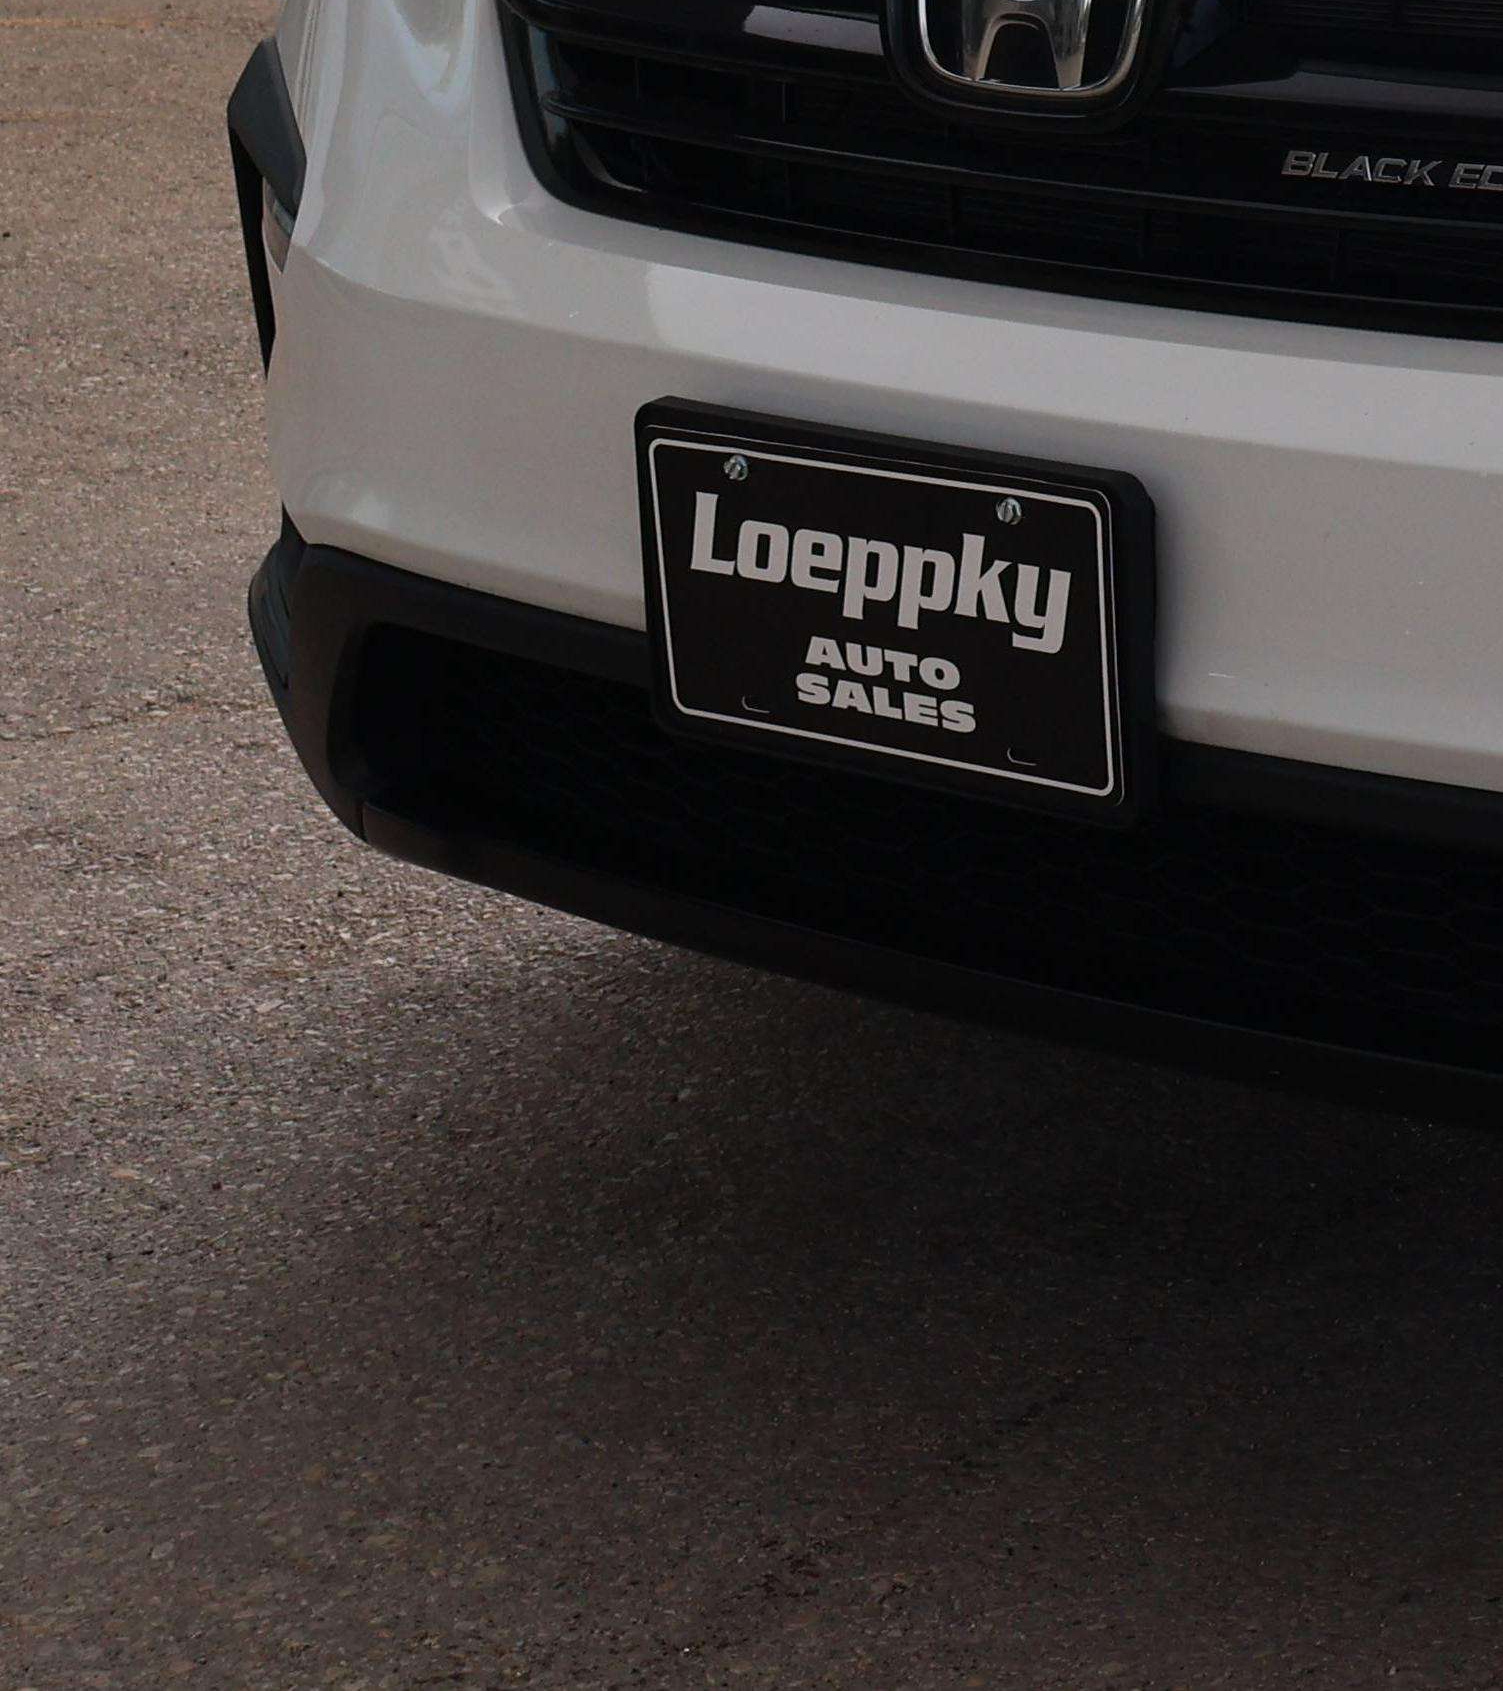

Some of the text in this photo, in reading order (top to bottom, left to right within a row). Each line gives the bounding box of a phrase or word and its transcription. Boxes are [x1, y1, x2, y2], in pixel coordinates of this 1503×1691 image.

[1280, 149, 1443, 187] BLACK
[689, 491, 1072, 655] Loeppky
[804, 635, 961, 691] AUTO
[794, 672, 977, 735] SALES
